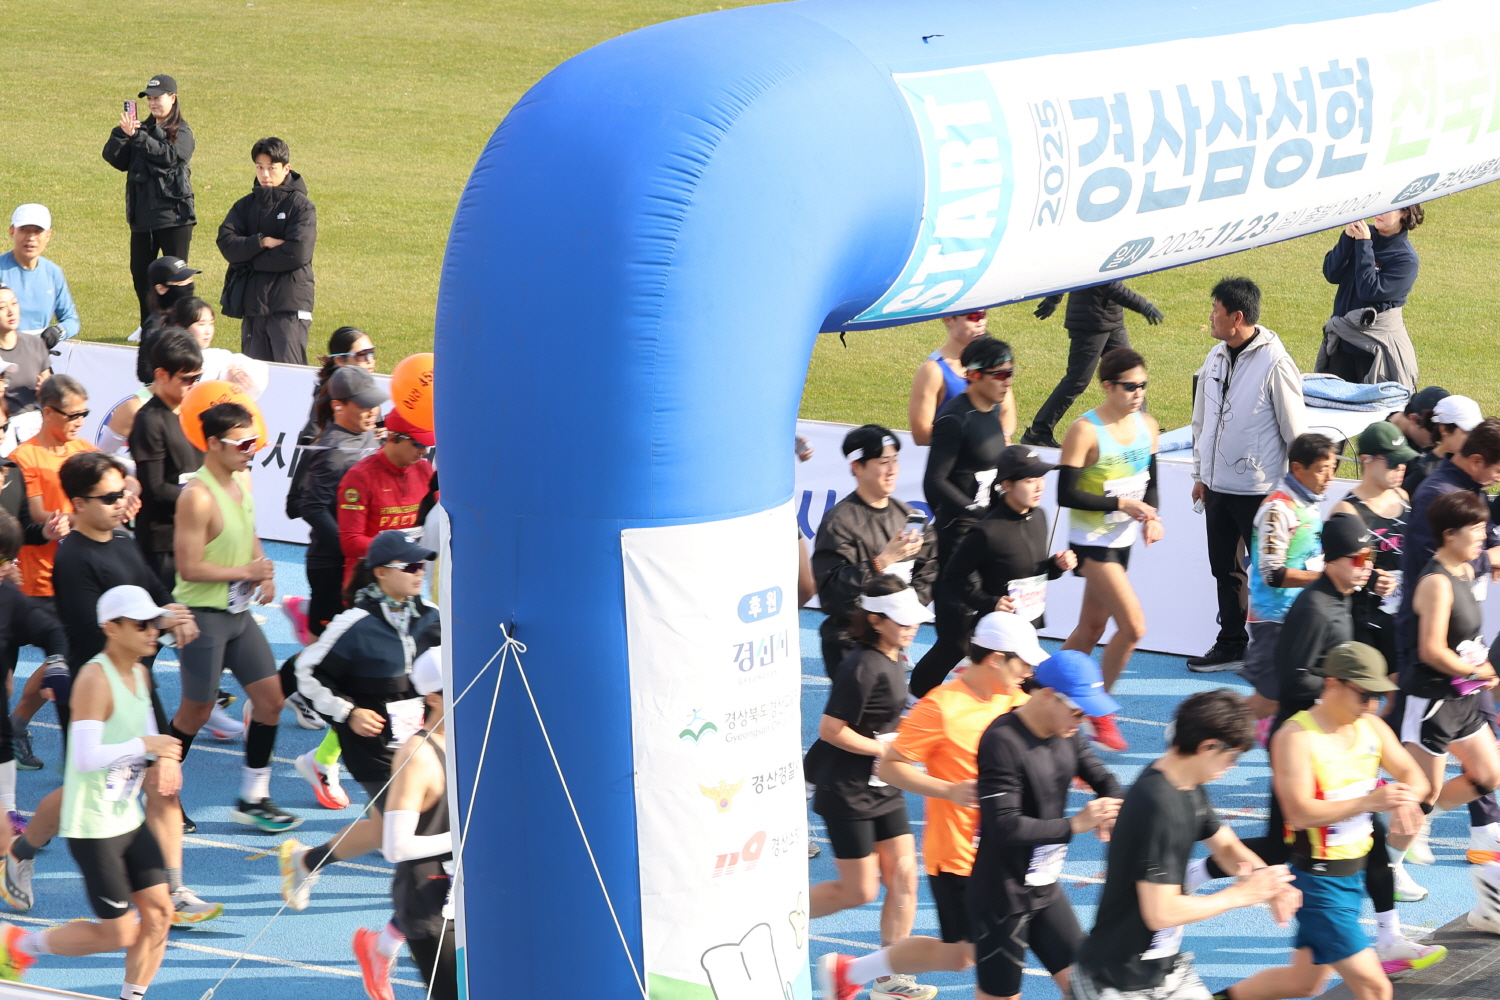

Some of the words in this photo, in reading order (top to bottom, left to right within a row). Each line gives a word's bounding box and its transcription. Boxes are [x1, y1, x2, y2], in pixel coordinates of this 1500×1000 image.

[1067, 57, 1373, 223] 경산삼성현
[1035, 99, 1065, 227] 2025
[882, 94, 1002, 313] START
[1399, 177, 1431, 200] 장소
[1105, 239, 1151, 269] 일시
[748, 590, 778, 618] 후원
[732, 629, 789, 673] 경산시
